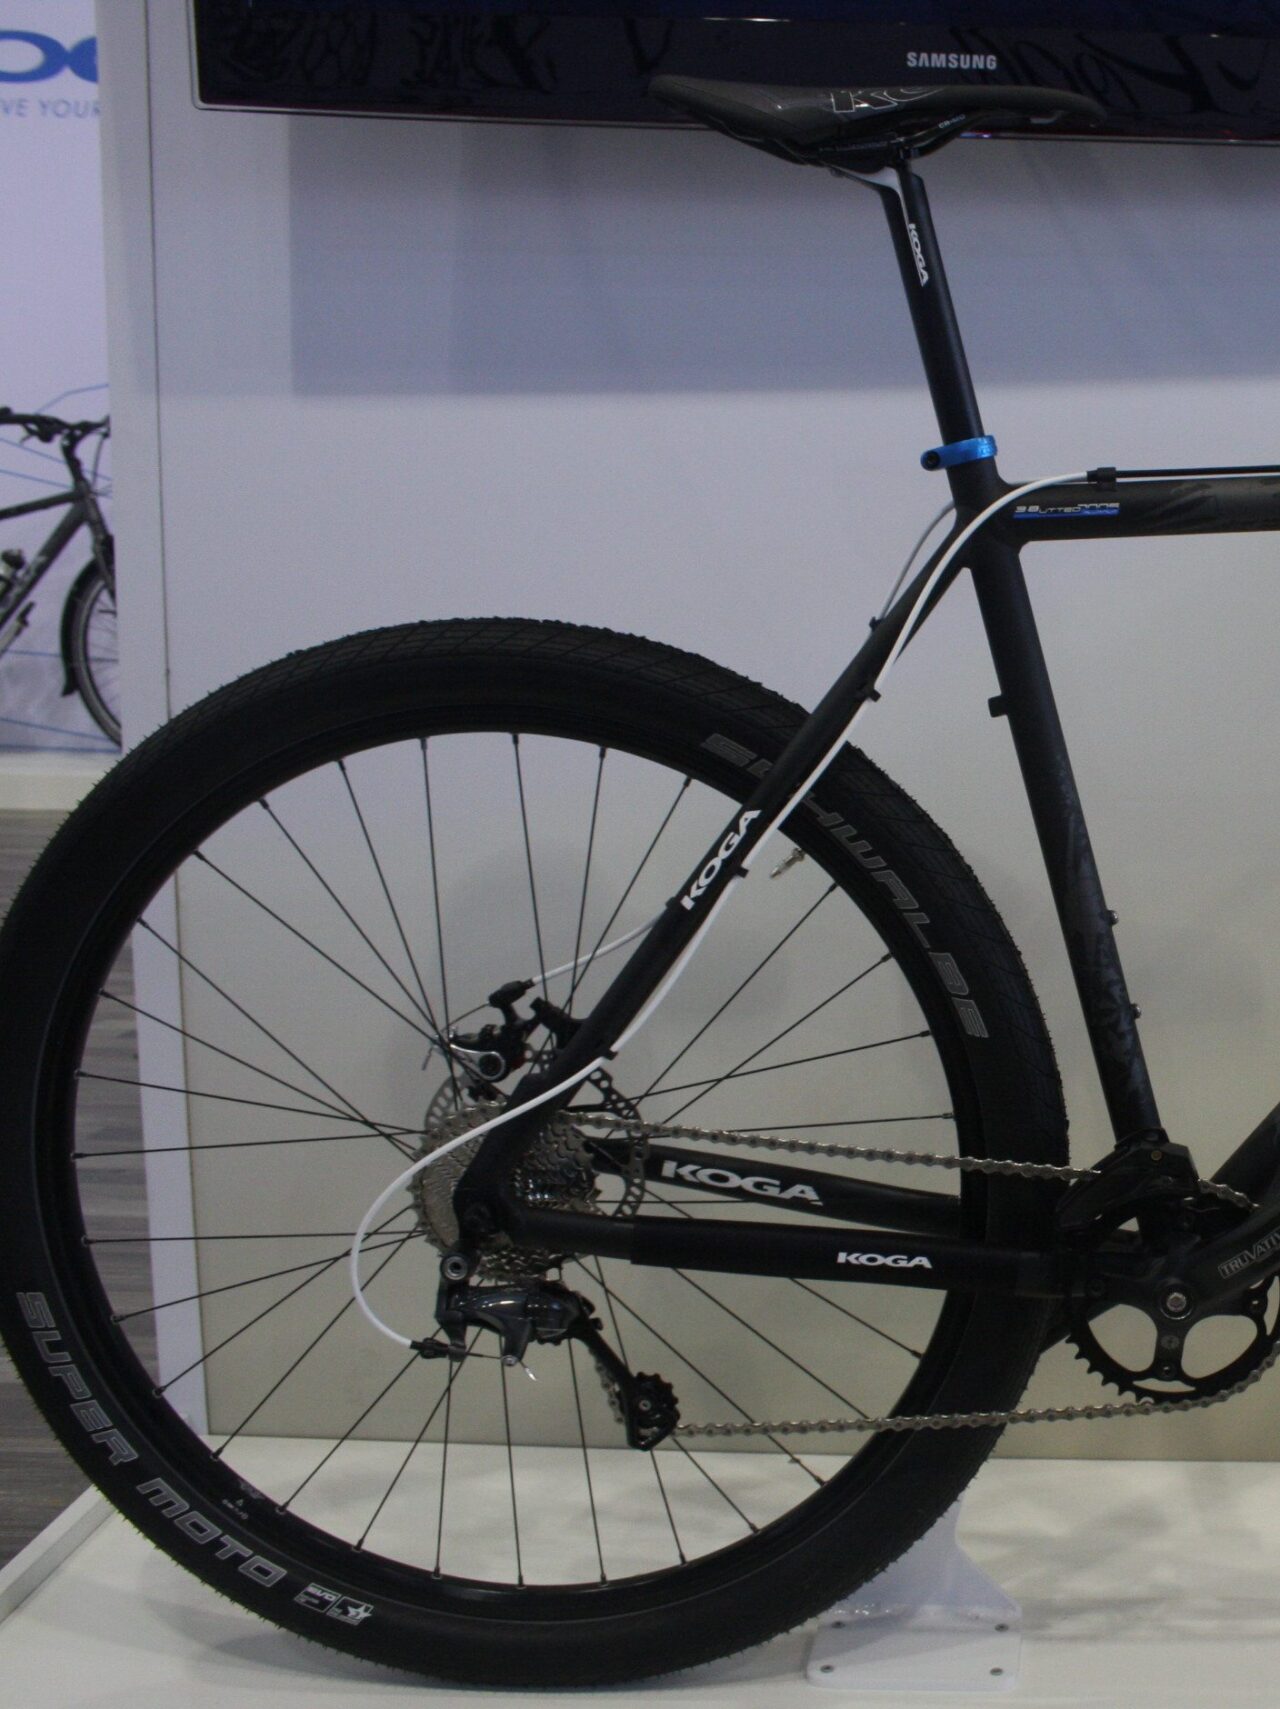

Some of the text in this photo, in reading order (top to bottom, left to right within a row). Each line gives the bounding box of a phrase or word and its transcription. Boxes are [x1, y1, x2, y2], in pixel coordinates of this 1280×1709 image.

[906, 52, 998, 71] SAMSUNG
[908, 223, 930, 287] KOGA
[680, 809, 762, 911] KOGA
[661, 1159, 824, 1207] KOGA
[836, 1251, 933, 1269] KOGA
[16, 1292, 138, 1466] SUPER
[136, 1477, 287, 1587] MOTO
